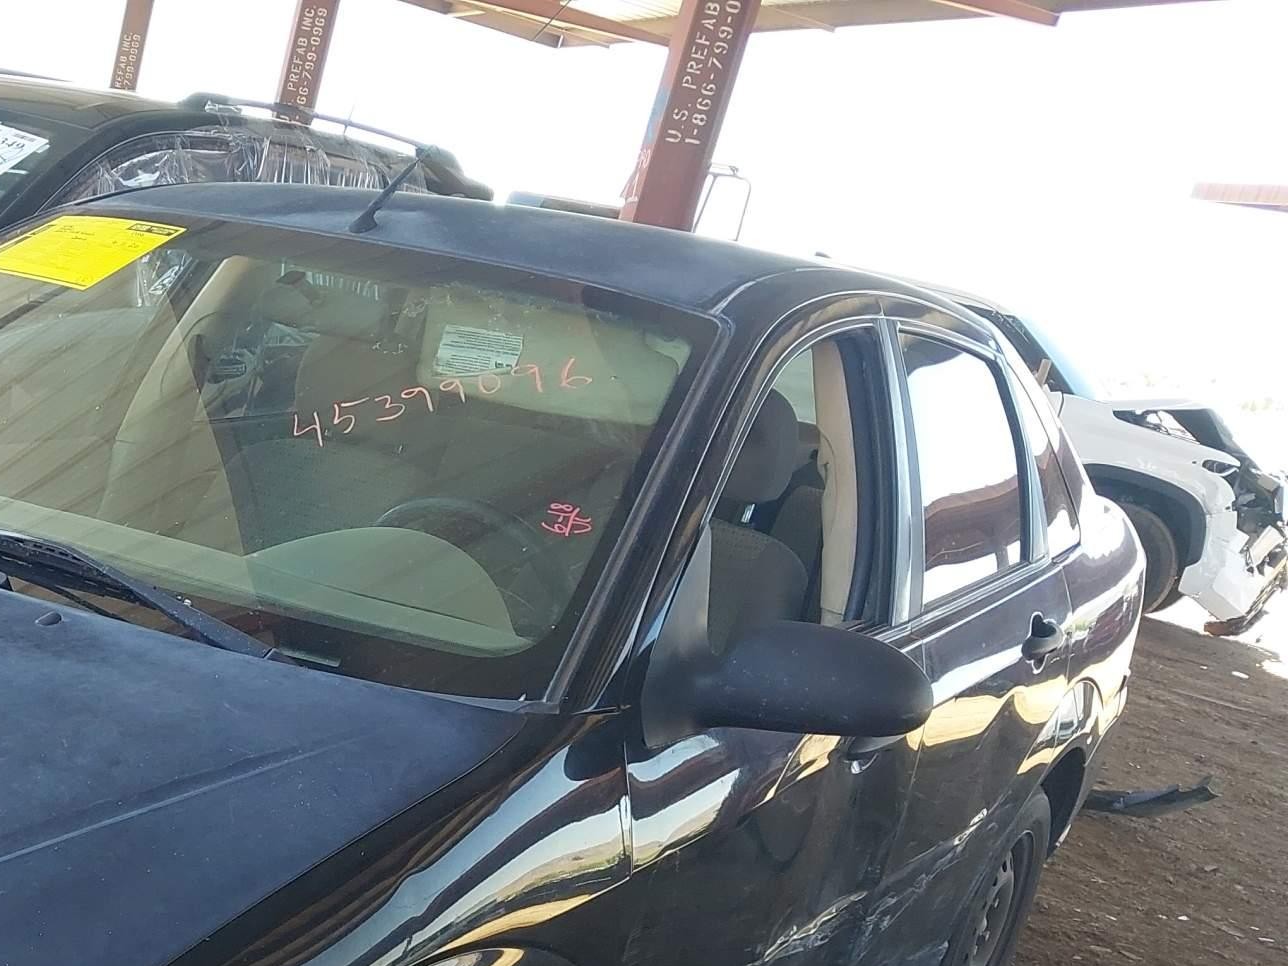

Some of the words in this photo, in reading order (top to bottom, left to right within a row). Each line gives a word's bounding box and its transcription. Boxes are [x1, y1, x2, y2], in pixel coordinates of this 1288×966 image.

[121, 32, 133, 51] INC.
[287, 36, 309, 91] PREFAB
[301, 5, 317, 31] INC.
[665, 104, 692, 143] U.S.
[682, 2, 721, 90] PREFAB
[685, 0, 742, 145] 1-866-799-0
[292, 357, 594, 447] 45399096
